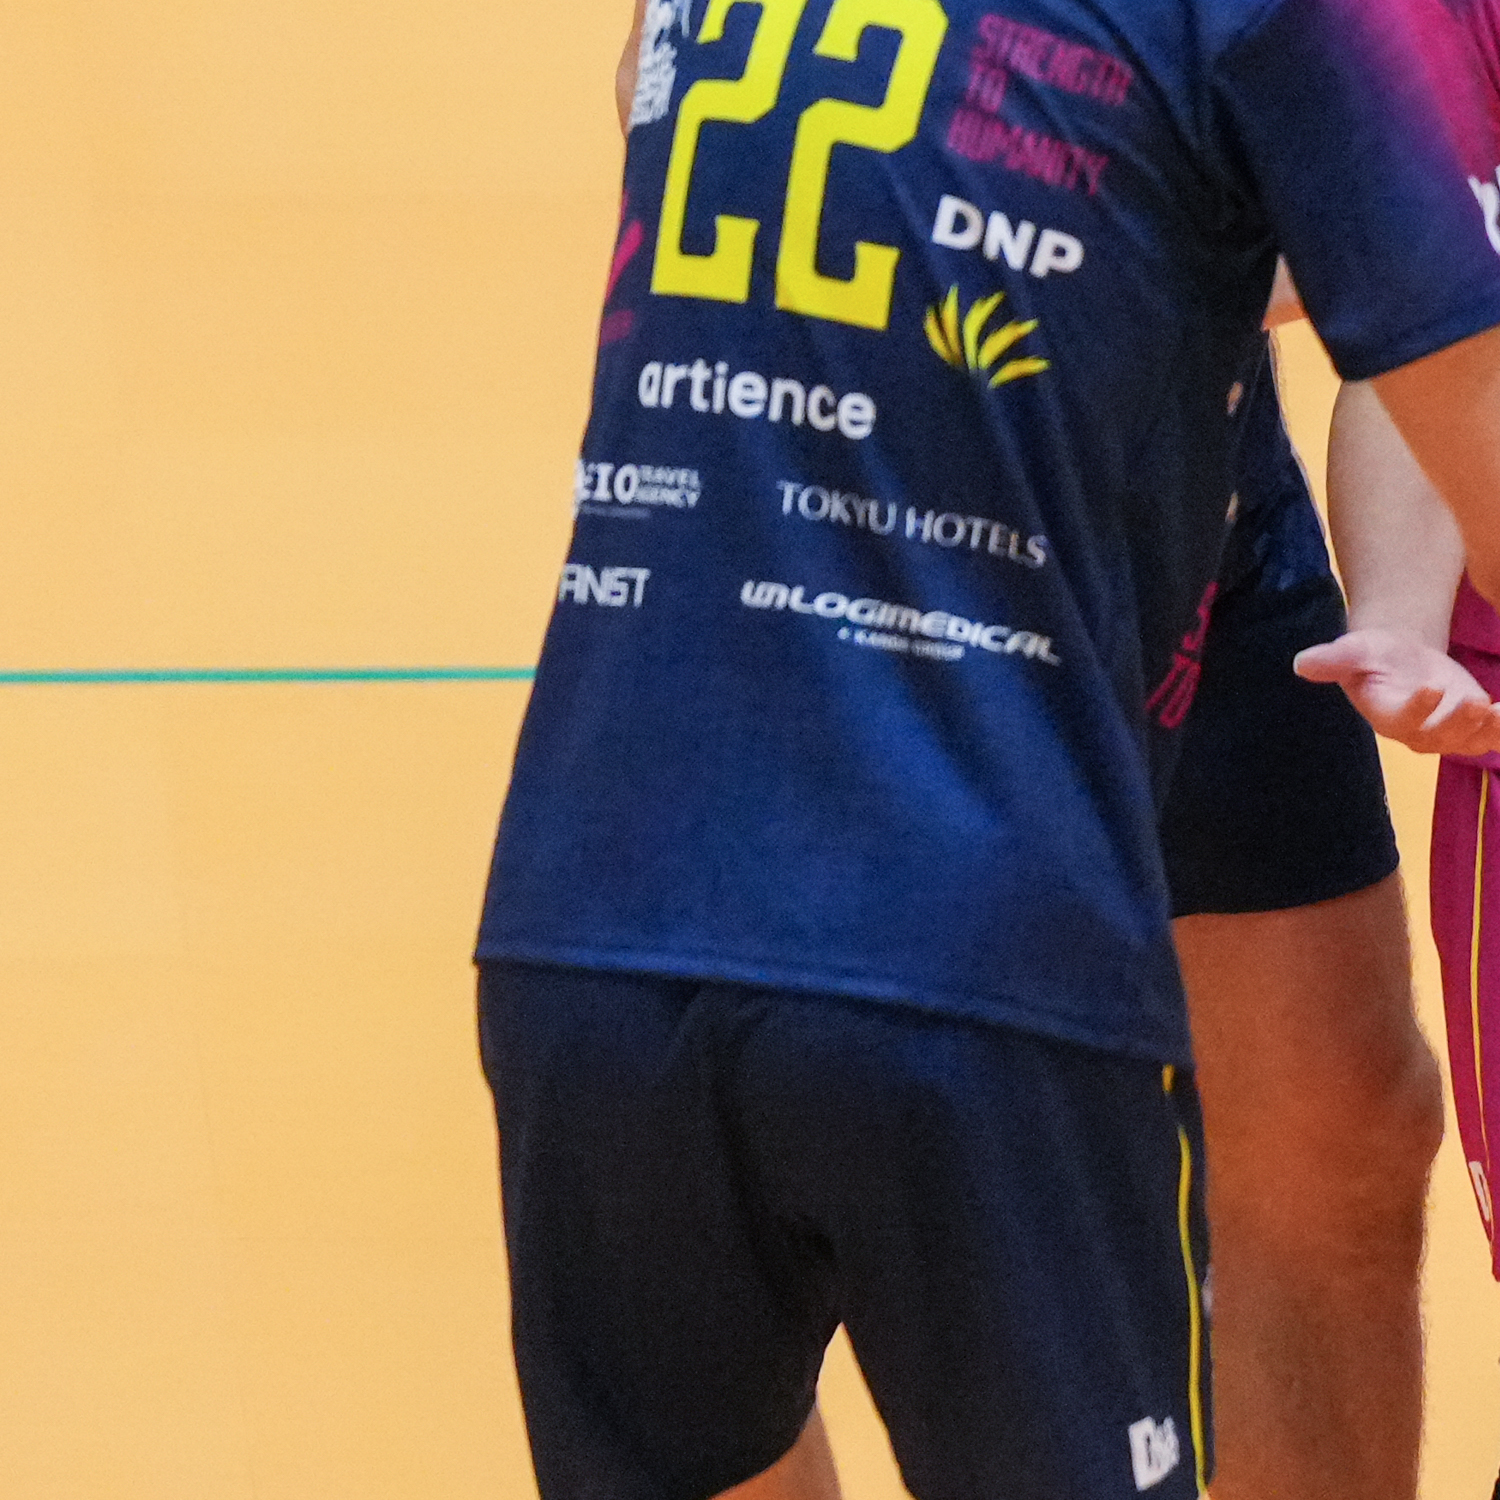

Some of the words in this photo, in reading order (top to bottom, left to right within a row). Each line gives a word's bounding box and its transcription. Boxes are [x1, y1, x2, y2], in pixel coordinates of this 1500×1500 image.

[932, 195, 1084, 278] DNP
[638, 357, 876, 440] artience
[776, 479, 897, 535] TOKYU
[905, 505, 1050, 568] HOTELS
